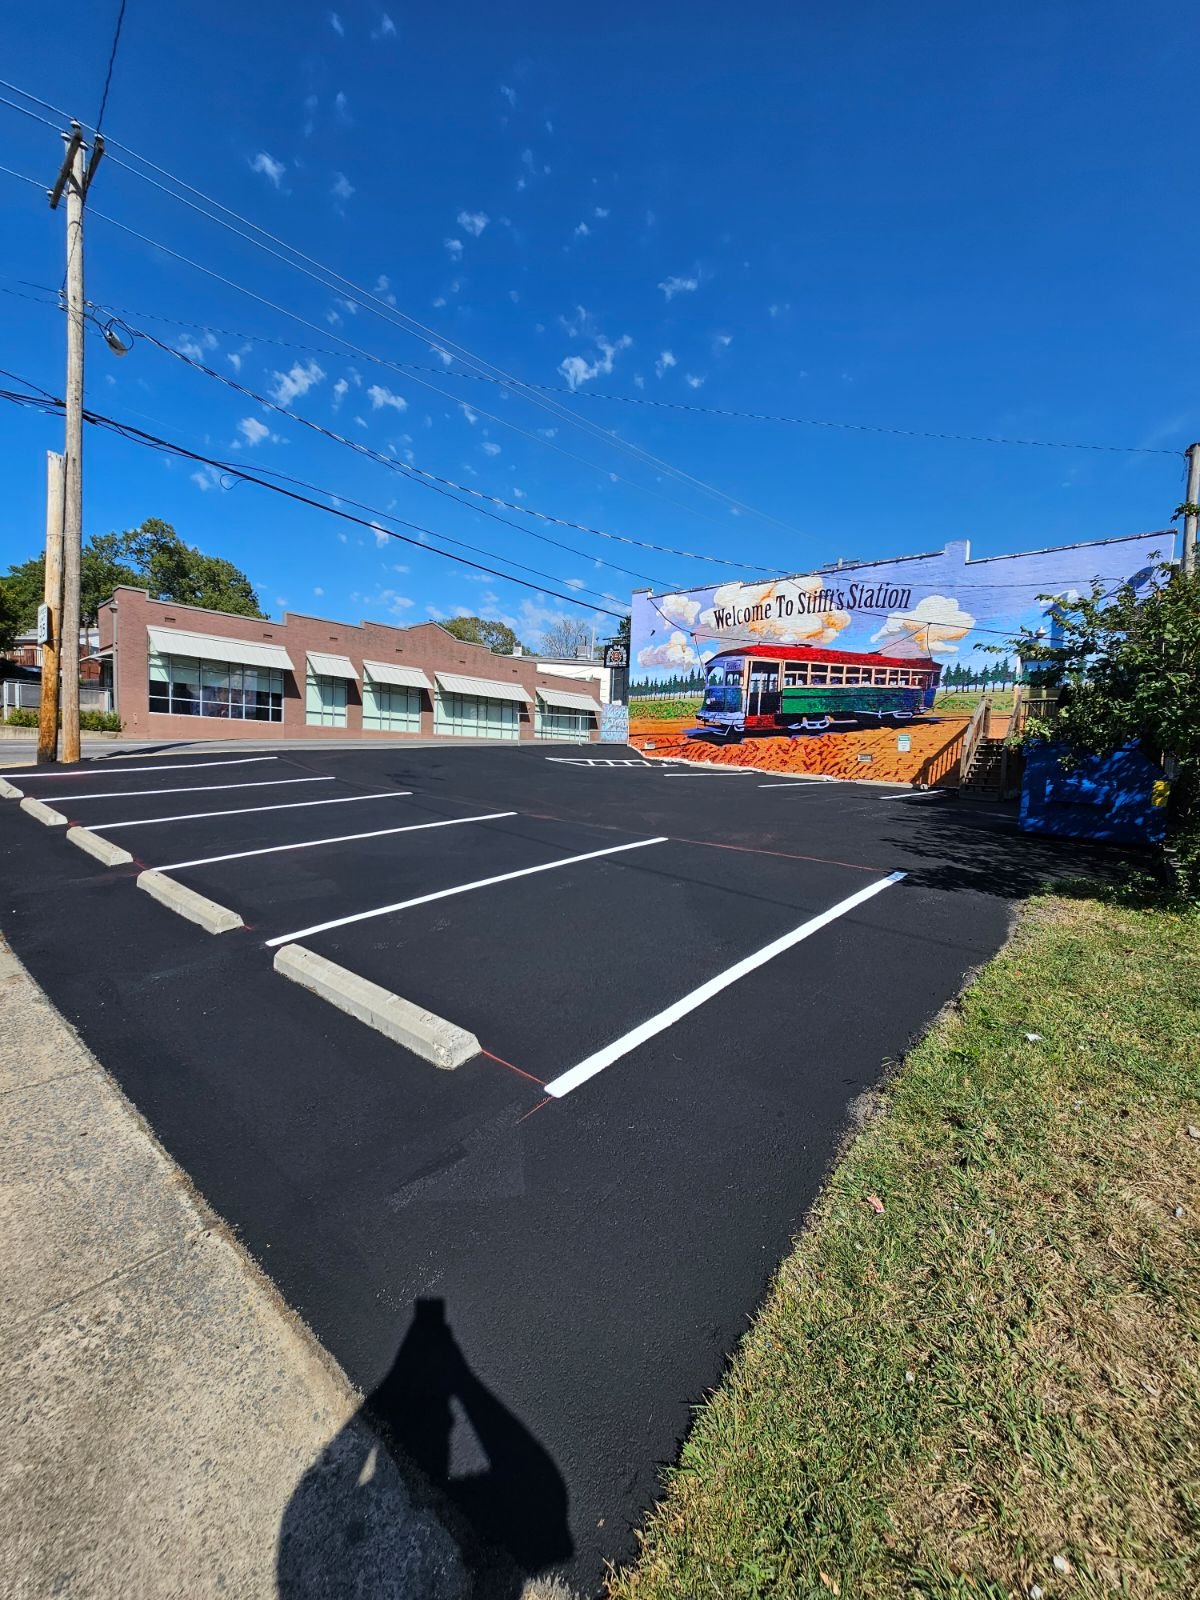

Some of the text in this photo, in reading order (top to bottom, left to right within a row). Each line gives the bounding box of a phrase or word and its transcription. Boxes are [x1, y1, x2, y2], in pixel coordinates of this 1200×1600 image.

[713, 583, 912, 630] Welcome To Stifft's Station
